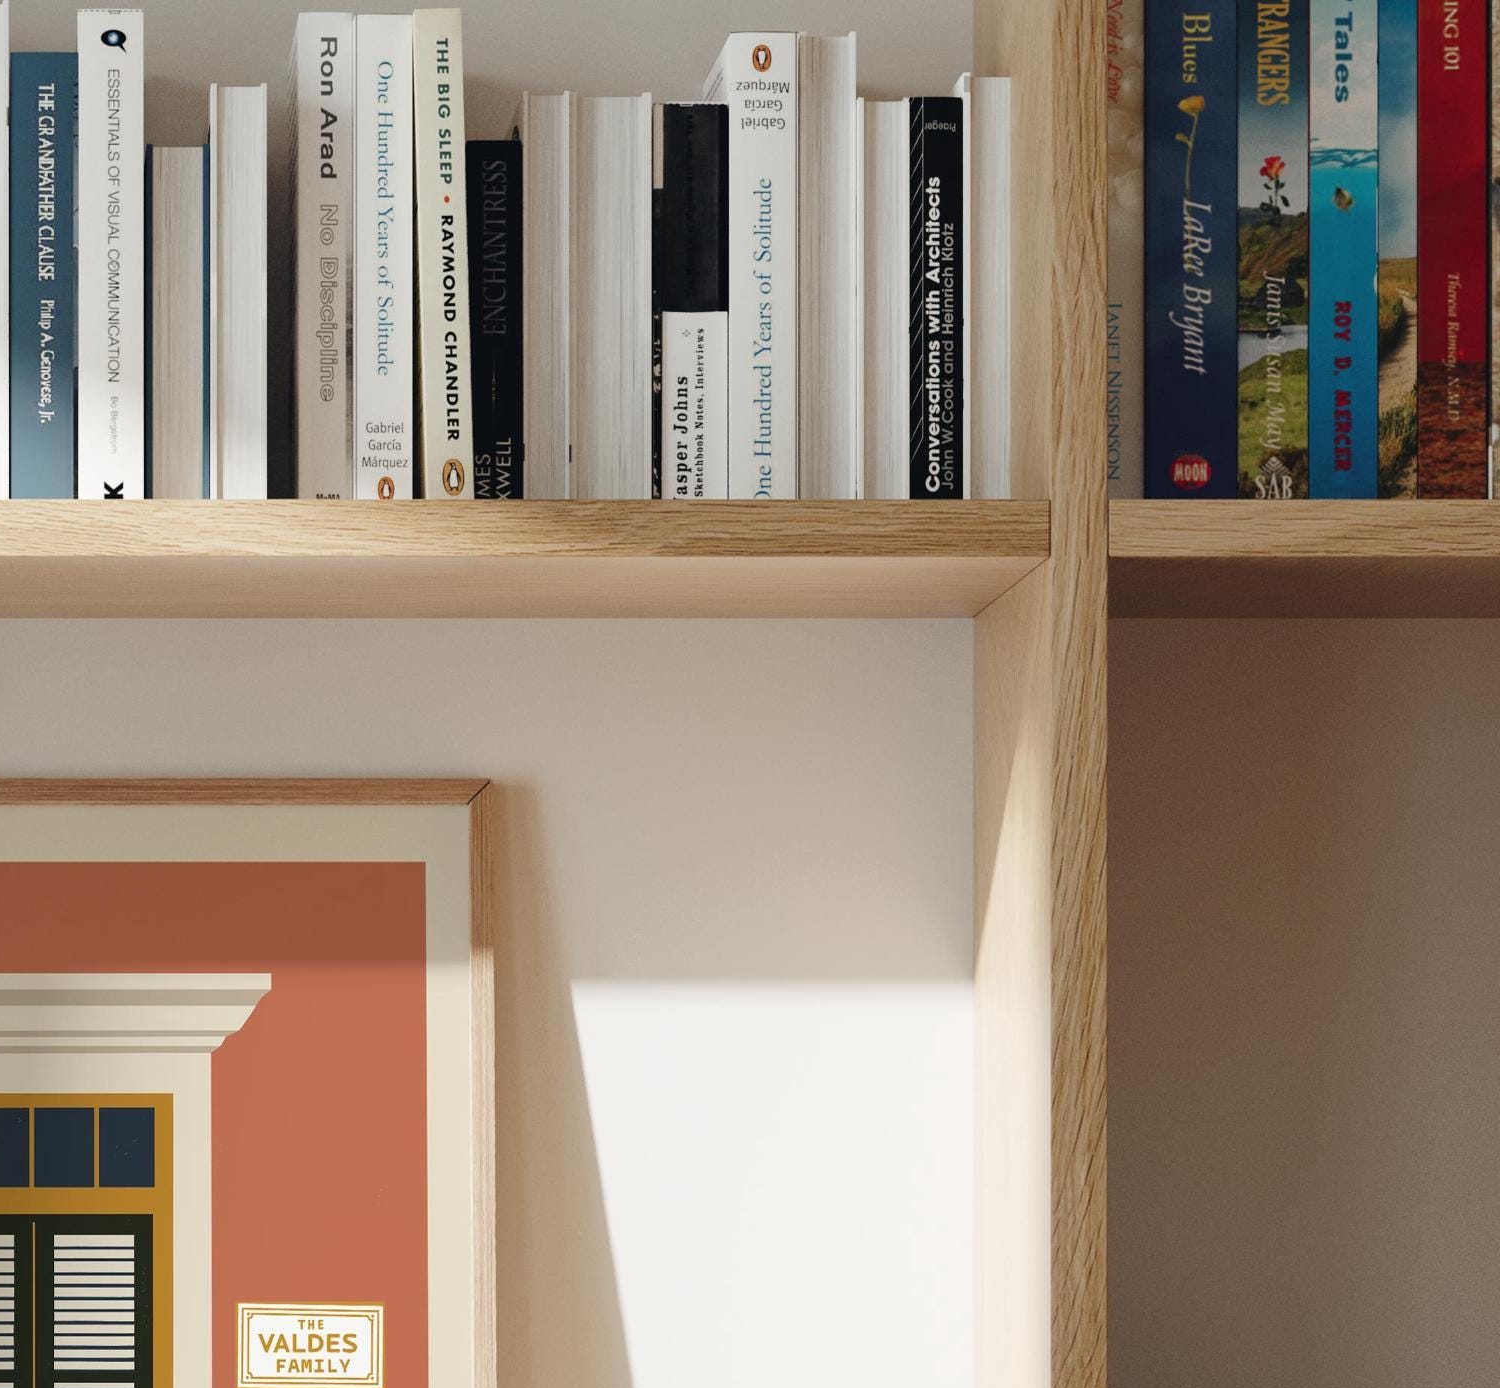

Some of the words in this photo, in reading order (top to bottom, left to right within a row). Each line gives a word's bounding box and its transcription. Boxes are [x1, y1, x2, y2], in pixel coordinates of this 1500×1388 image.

[320, 36, 337, 96] Ron
[436, 38, 449, 75] THE
[1182, 13, 1212, 84] Blues
[1335, 13, 1353, 102] Tales
[1443, 45, 1459, 71] 101
[38, 83, 54, 112] THE
[377, 61, 394, 103] One
[437, 84, 450, 119] BIG
[320, 108, 337, 179] Arad
[741, 117, 786, 130] Gabriel
[924, 120, 956, 132] Praeger
[38, 117, 54, 219] GRANDFATHER
[377, 112, 394, 200] Hundred
[438, 129, 452, 184] SLEEP
[320, 204, 337, 246] No
[377, 207, 394, 259] Years
[754, 177, 772, 262] Solitude
[926, 177, 941, 284] Architects
[942, 223, 954, 260] Klotz
[1182, 198, 1211, 275] LaRee
[38, 225, 54, 281] CLAUSE
[377, 266, 394, 288] of
[441, 215, 456, 322] RAYMOND
[754, 271, 772, 295] of
[942, 267, 954, 335] Heinrich
[1264, 272, 1285, 327] Janis
[1446, 273, 1459, 318] Theresa
[316, 257, 338, 403] Discipline
[377, 297, 394, 376] Solitude
[754, 302, 772, 358] Years
[926, 290, 941, 334] with
[1170, 283, 1211, 374] Bryant
[1335, 302, 1350, 341] ROY
[444, 332, 459, 441] CHANDLER
[695, 328, 704, 390] Interviews
[942, 341, 954, 379] and
[1264, 331, 1285, 394] Susan
[366, 421, 404, 435] Gabriel
[674, 376, 689, 433] Johns
[695, 395, 704, 430] Notes,
[754, 364, 772, 458] Hundred
[926, 341, 941, 492] Conversations
[1108, 371, 1122, 480] NISSENSON
[1335, 390, 1350, 471] MERCER
[361, 455, 408, 471] Márquez
[368, 438, 402, 452] García
[695, 434, 704, 497] Sketchbook
[942, 461, 954, 490] John
[1174, 464, 1208, 483] MOON
[258, 1333, 358, 1353] VALDES
[298, 1319, 325, 1331] THE
[276, 1359, 351, 1373] FAMILY
